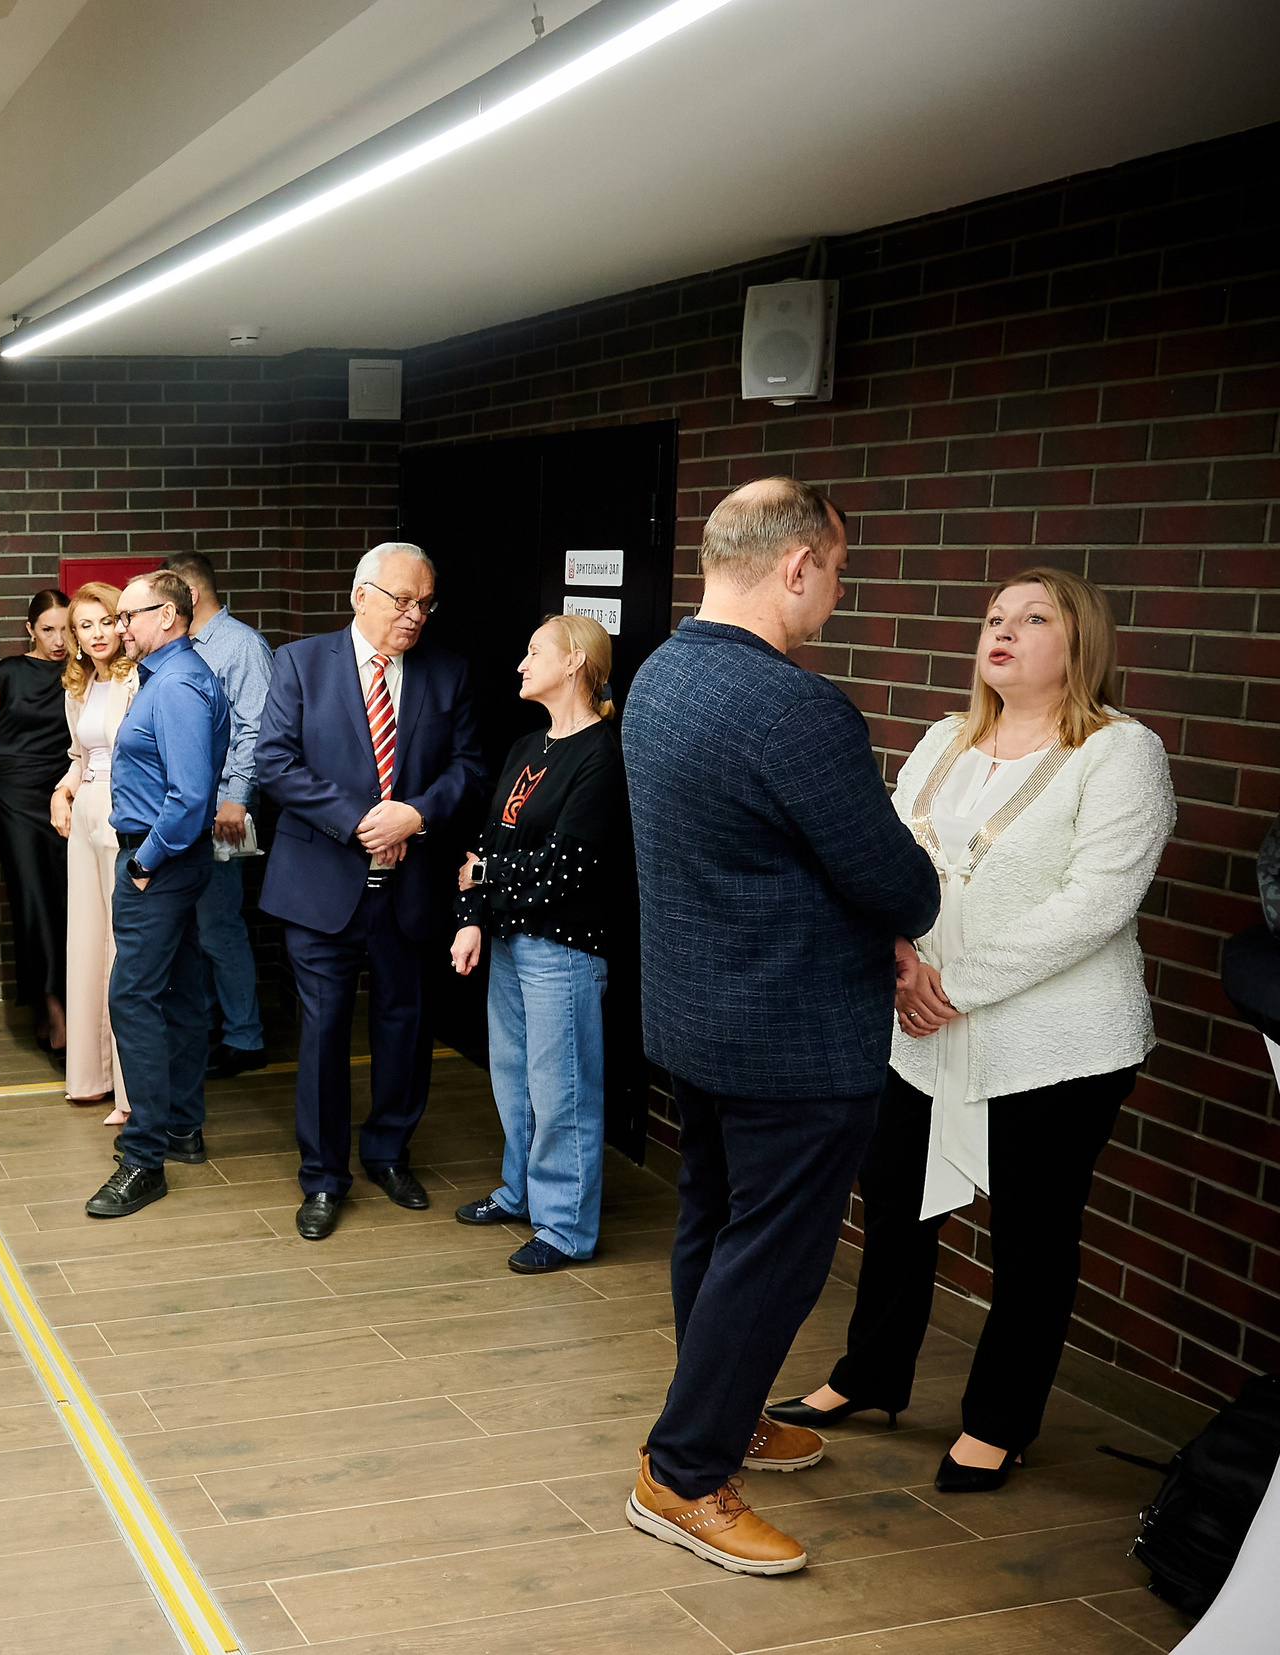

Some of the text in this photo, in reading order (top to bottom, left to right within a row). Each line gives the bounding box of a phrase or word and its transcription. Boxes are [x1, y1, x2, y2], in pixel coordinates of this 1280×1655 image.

[576, 562, 619, 575] ЗРИТЕЛЬНЫЙ ЗАЛ
[609, 610, 617, 624] 25
